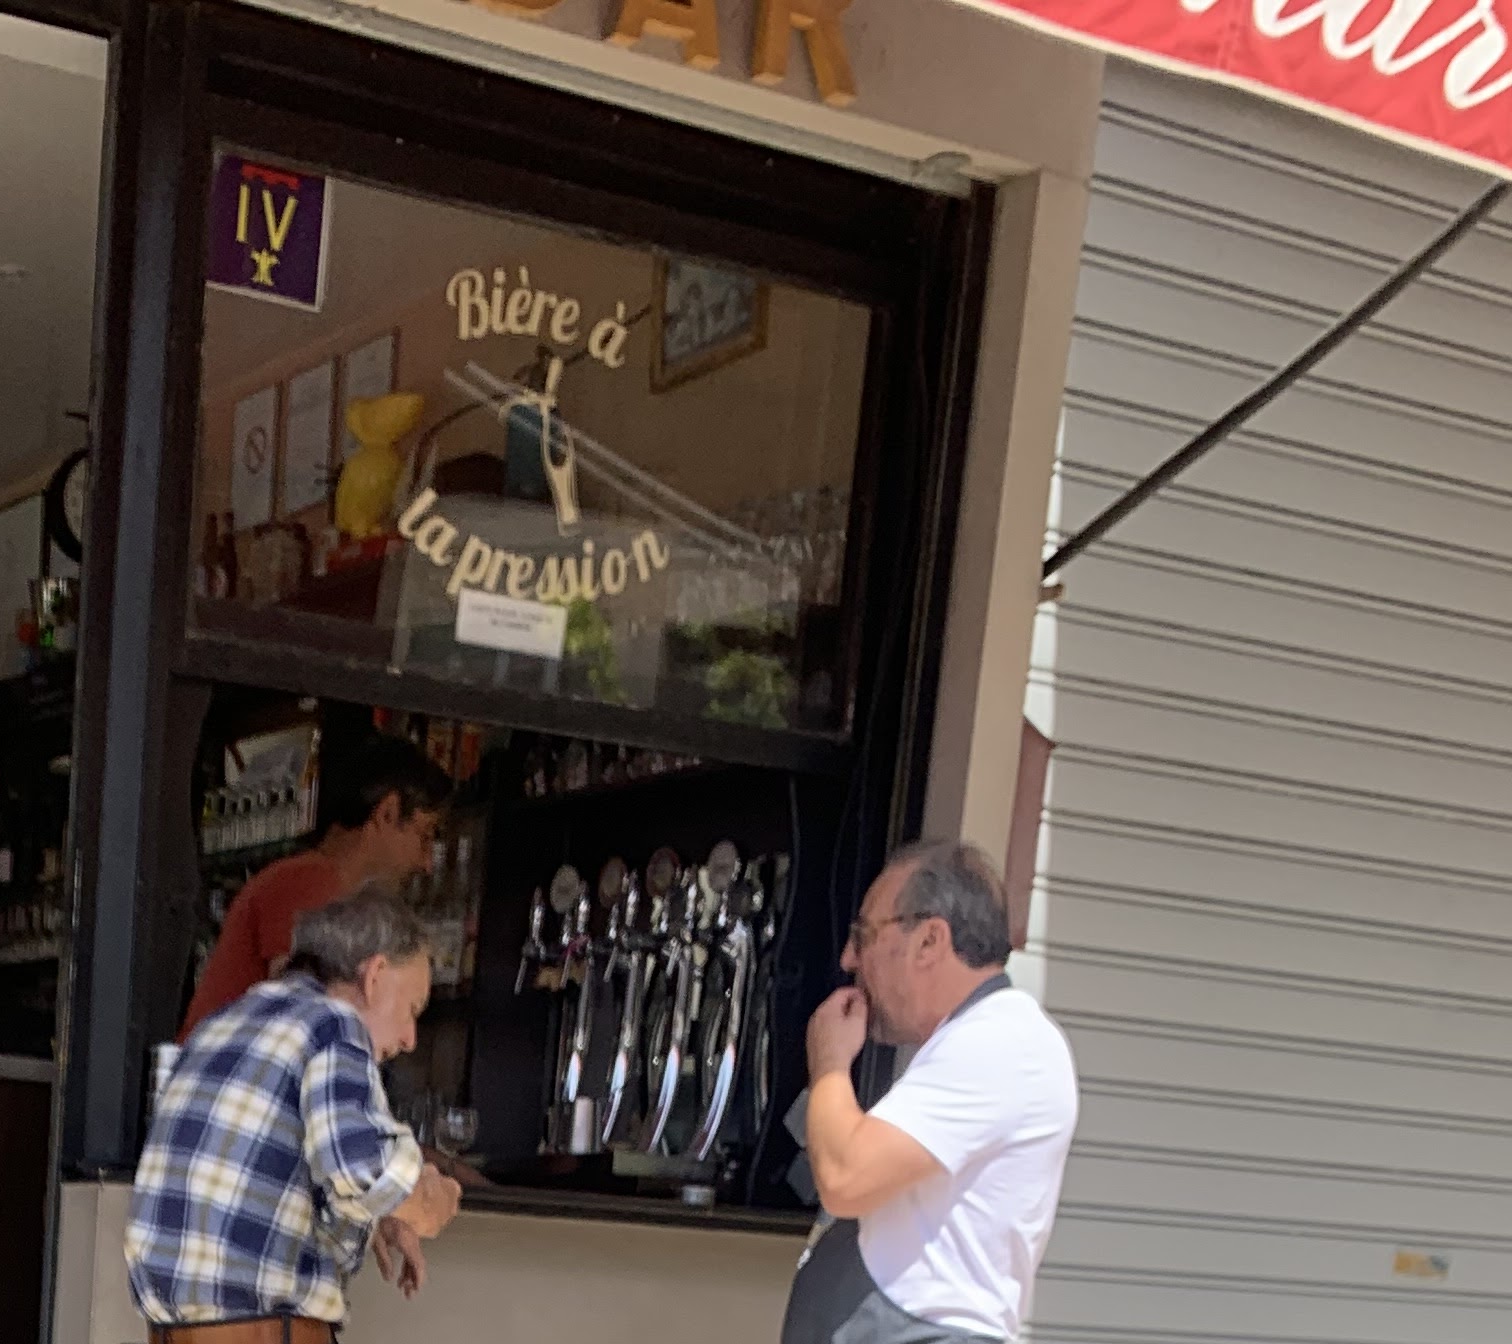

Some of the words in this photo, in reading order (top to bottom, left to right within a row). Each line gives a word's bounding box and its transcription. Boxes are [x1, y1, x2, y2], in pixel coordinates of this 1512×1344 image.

[472, 0, 857, 108] AR
[236, 183, 299, 252] IV
[446, 265, 581, 345] Bière
[588, 301, 627, 369] à
[397, 487, 459, 567] la
[447, 529, 670, 604] pression
